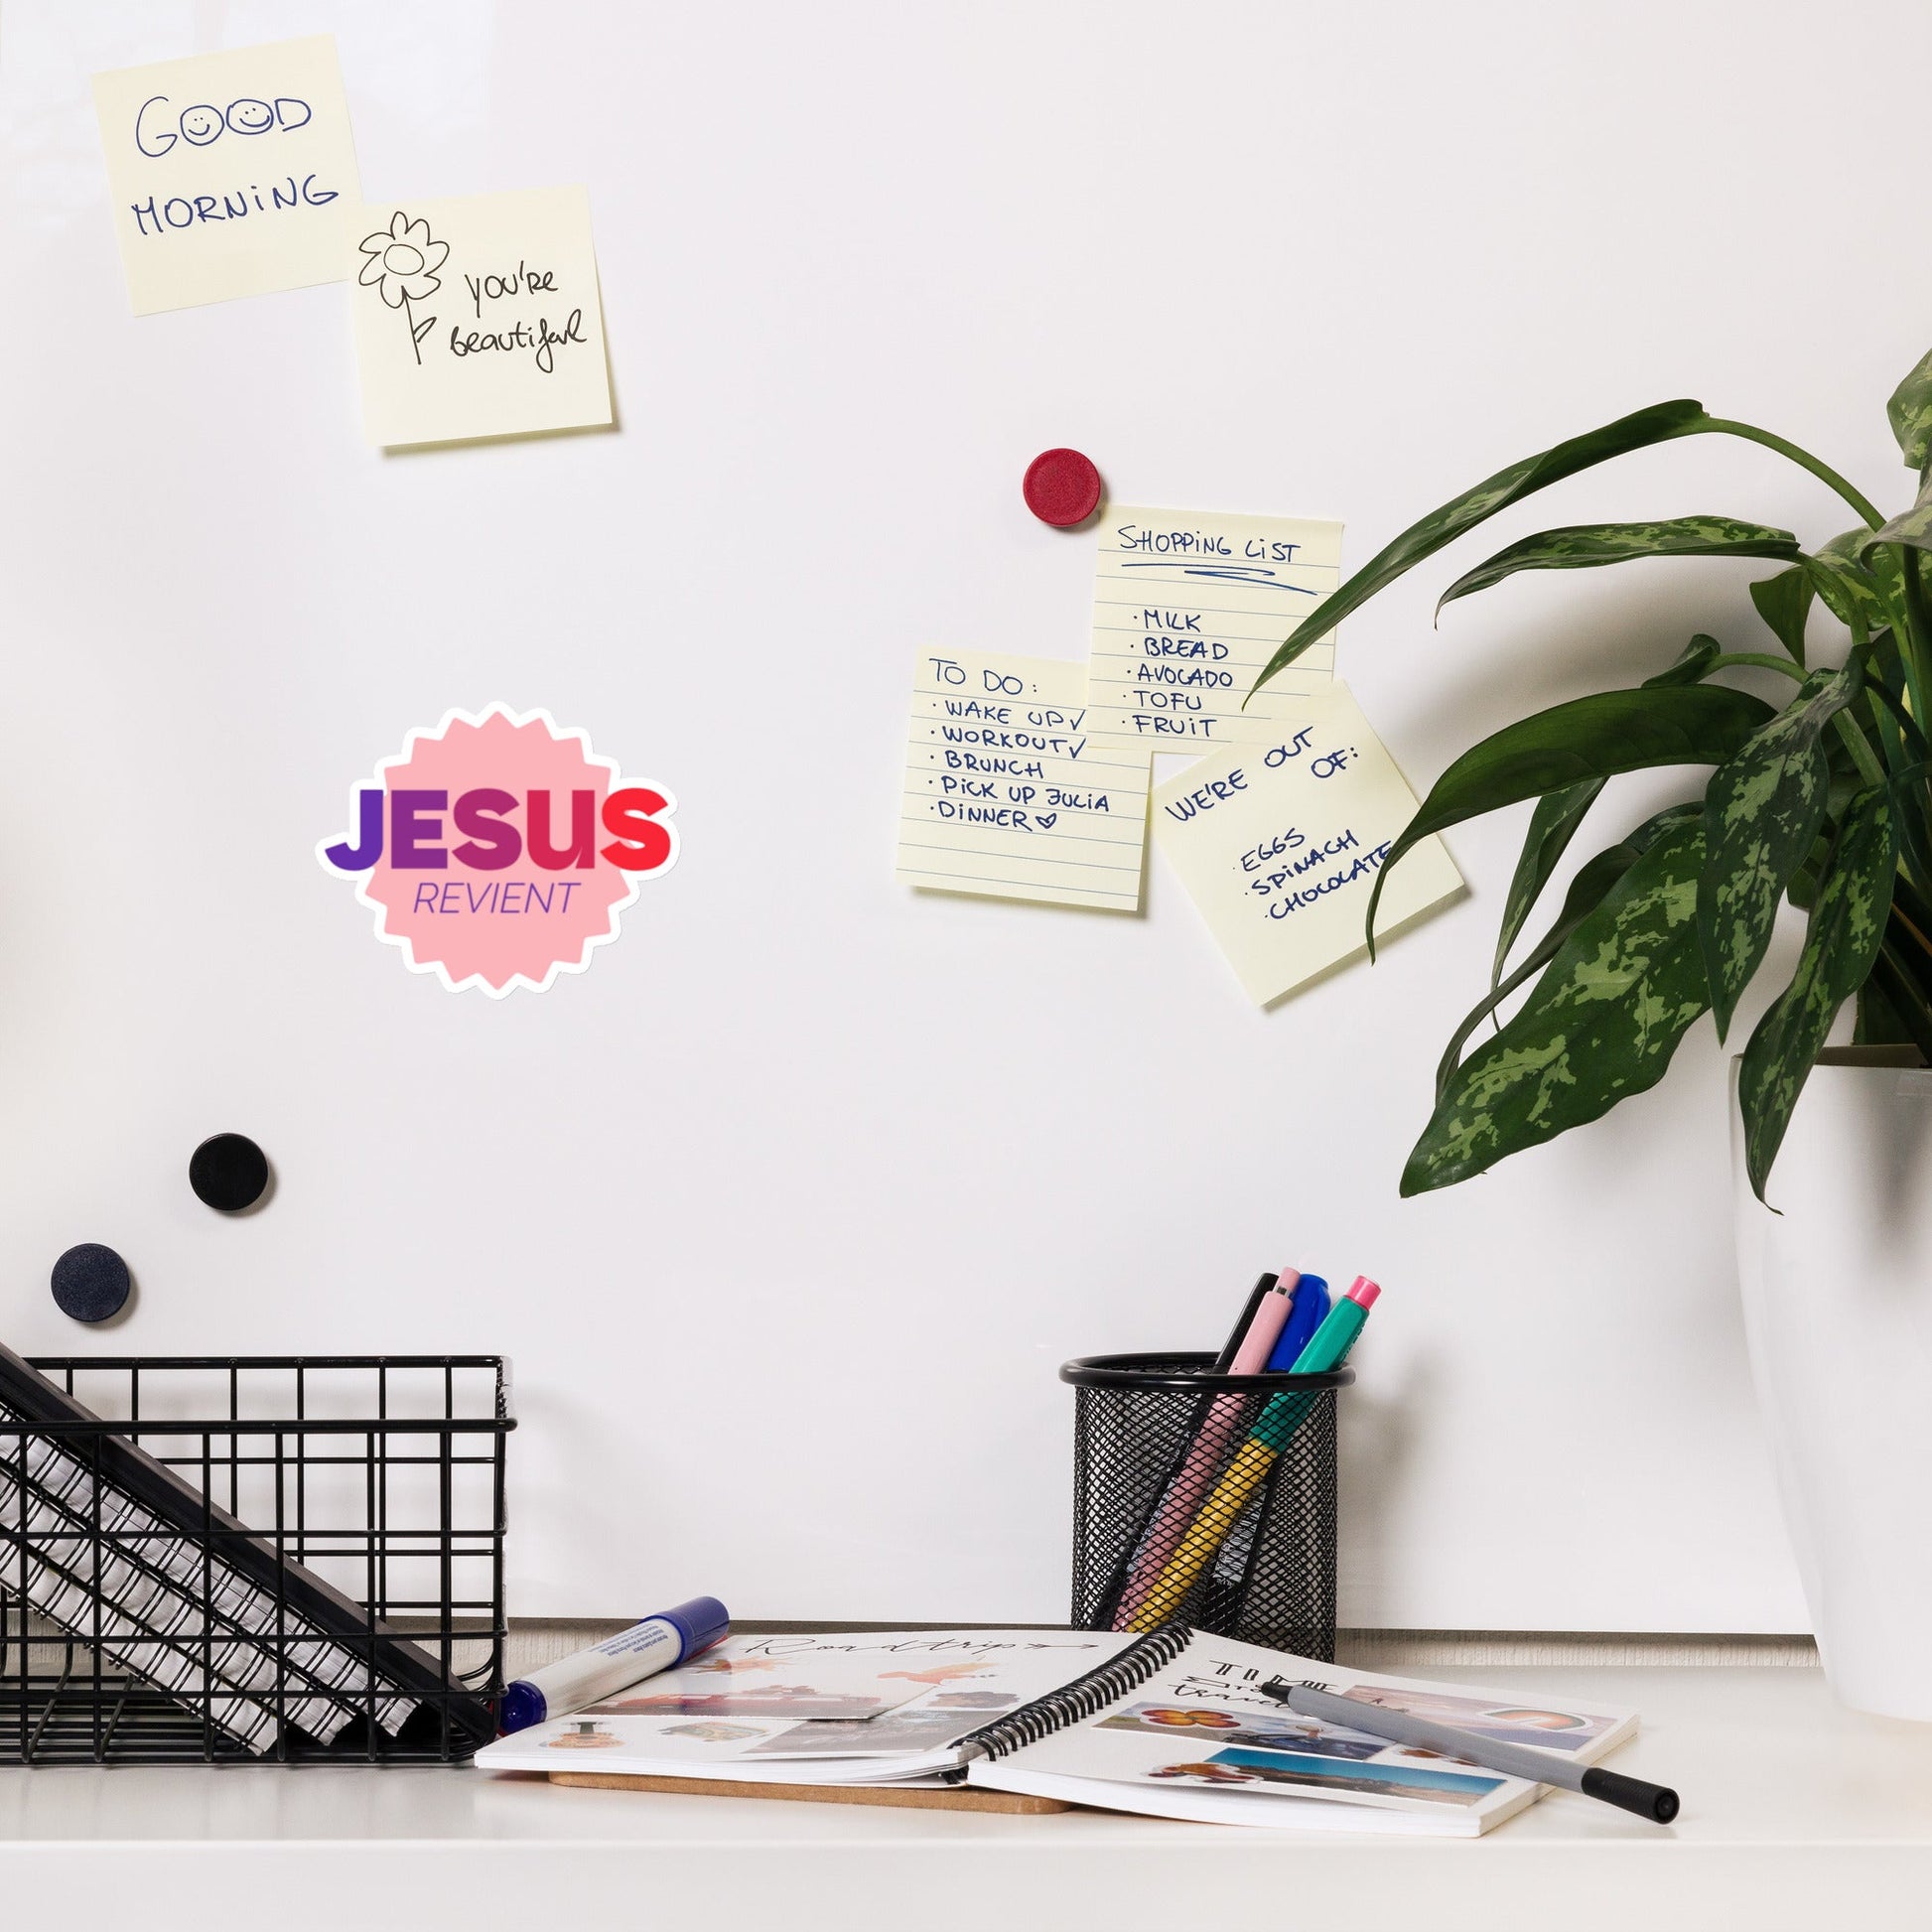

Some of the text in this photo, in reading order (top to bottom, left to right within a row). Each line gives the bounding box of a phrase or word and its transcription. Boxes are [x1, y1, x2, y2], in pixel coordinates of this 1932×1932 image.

[136, 96, 311, 157] GOOD
[450, 308, 587, 373] beautiful
[1143, 609, 1201, 632] MILK
[1143, 635, 1230, 661] BREAD
[928, 656, 967, 685] TO
[1137, 662, 1234, 689] AVOCADO
[944, 698, 1065, 728] WAKE UP
[1132, 689, 1203, 711] TOFU
[941, 725, 1069, 754] WORKOUT
[943, 749, 1045, 780] BRUNCH
[1164, 725, 1315, 823] WE'RE OUT
[1008, 785, 1036, 805] UP
[325, 788, 671, 871] JESUS
[413, 883, 582, 913] REVIENT
